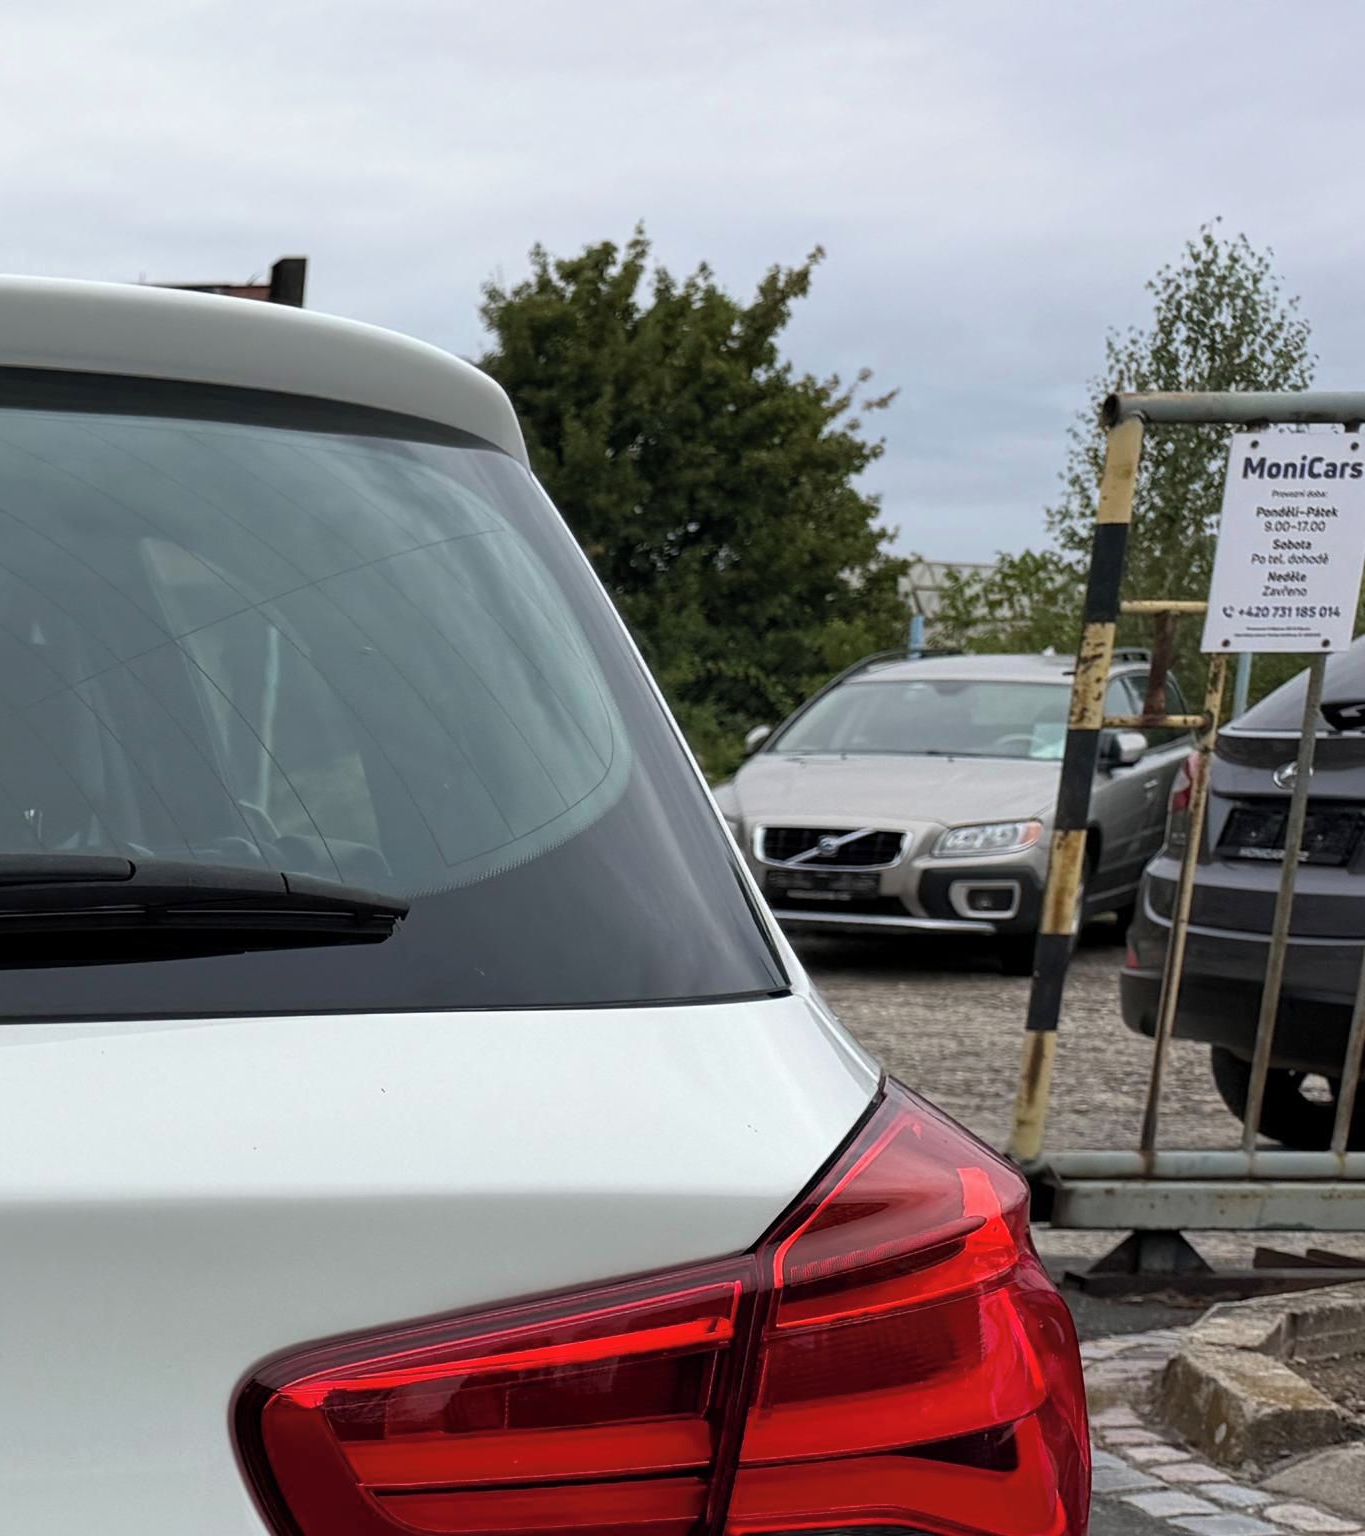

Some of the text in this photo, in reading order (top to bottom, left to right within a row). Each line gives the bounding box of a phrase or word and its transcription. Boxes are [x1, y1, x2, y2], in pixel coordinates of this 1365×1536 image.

[1242, 455, 1364, 480] MoniCars
[1272, 538, 1312, 550] Sobota
[1251, 553, 1266, 564] Po
[1267, 571, 1307, 583] Neděle
[1262, 585, 1308, 597] Zavřeno
[1238, 606, 1341, 618] +420 731 185 014
